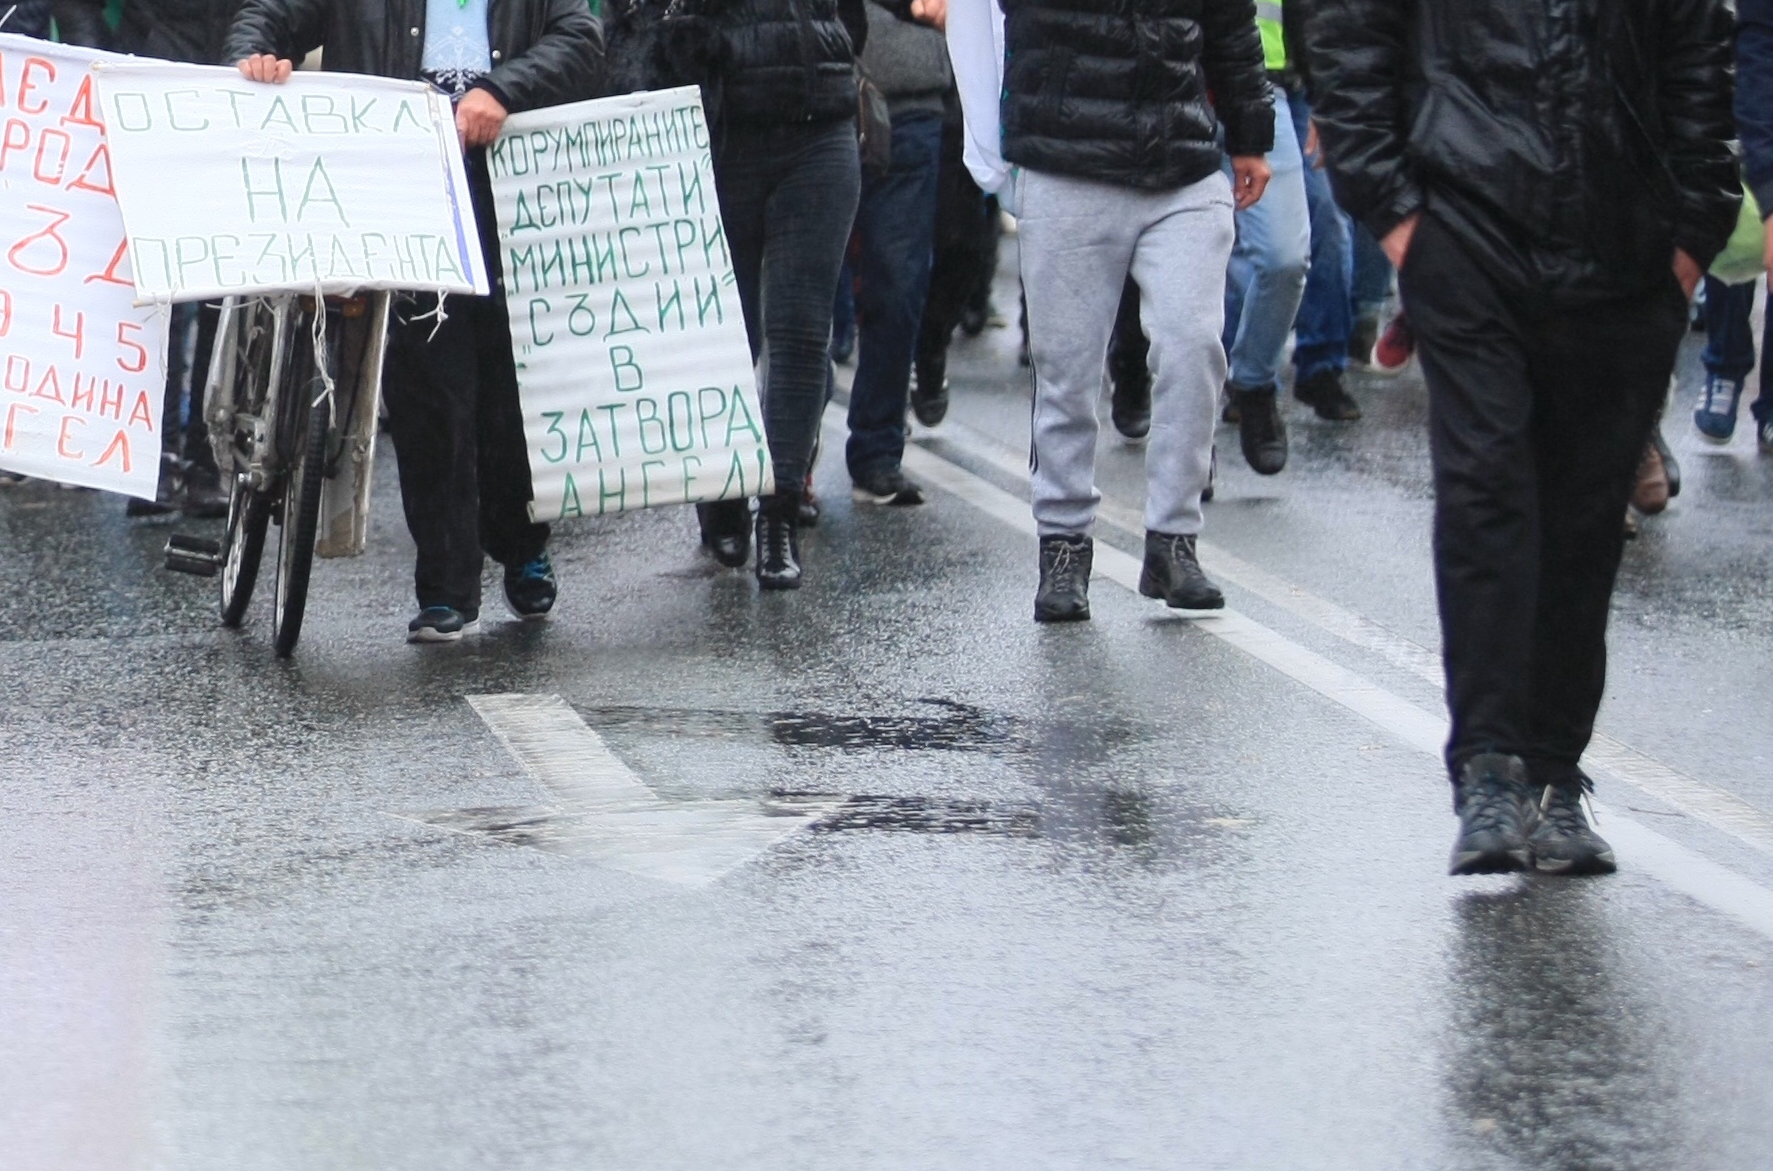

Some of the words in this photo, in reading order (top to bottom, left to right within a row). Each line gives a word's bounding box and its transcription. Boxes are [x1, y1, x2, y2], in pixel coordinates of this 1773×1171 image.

[490, 105, 709, 177] КОРУМПИРАНИТЕ
[241, 156, 351, 228] НА
[132, 232, 465, 290] ПРЕЗИДЕНТА
[609, 345, 644, 392] В
[540, 384, 763, 464] ЗАТВОРА
